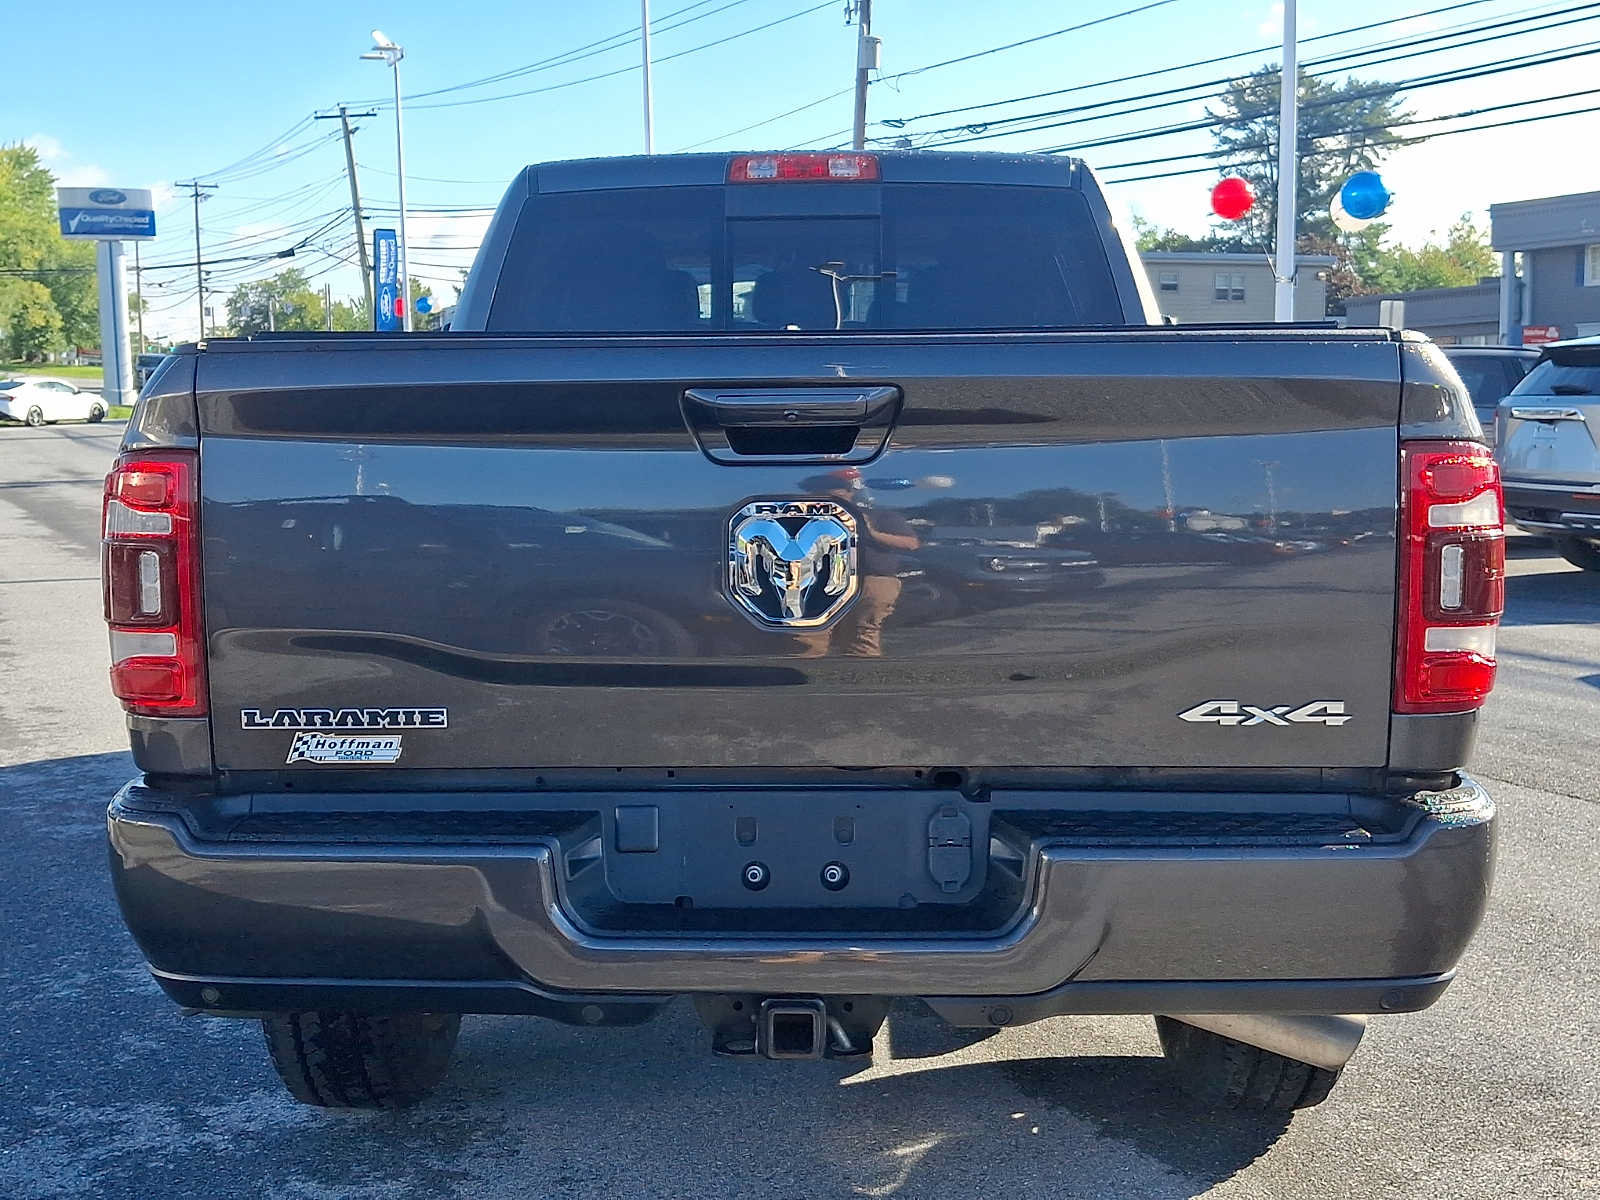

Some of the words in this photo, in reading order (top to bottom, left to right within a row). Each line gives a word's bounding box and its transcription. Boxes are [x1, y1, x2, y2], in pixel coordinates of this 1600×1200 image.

[755, 504, 830, 514] RAM
[241, 708, 448, 729] LARAMIE
[314, 738, 394, 749] Hoffman
